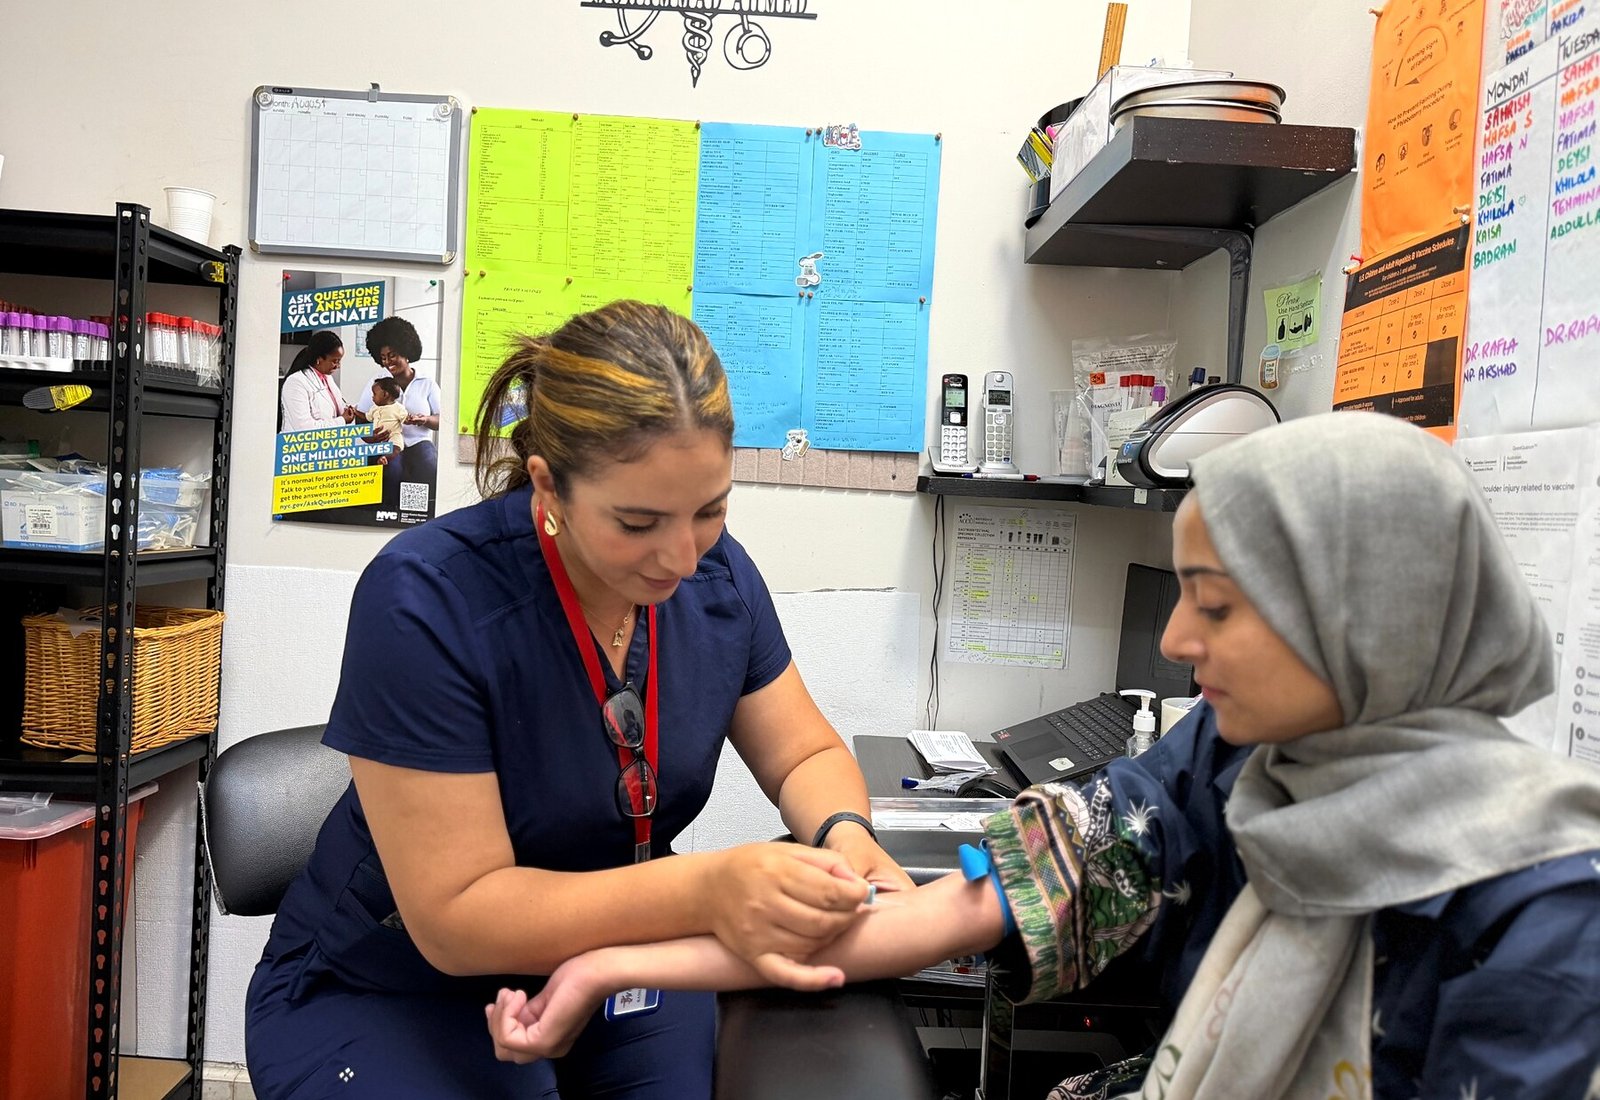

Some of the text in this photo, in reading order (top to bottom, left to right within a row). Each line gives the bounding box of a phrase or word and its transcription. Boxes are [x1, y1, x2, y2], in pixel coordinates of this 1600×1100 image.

[1487, 67, 1529, 105] MONDAY
[1561, 76, 1600, 108] HAFSA
[1485, 92, 1531, 130] SAHRISH
[1559, 100, 1595, 129] HAFSA
[1483, 121, 1517, 149] HAFSA
[1524, 110, 1533, 129] S
[1557, 120, 1597, 152] FATIMA
[1482, 141, 1513, 170] HAFSA
[1519, 133, 1528, 150] N
[1557, 144, 1591, 175] DEYSI
[1480, 163, 1513, 189] FATIMA
[1555, 166, 1595, 196] KHILOLA
[1478, 185, 1506, 210] DEYSI
[1478, 199, 1515, 226] KHILOLA
[1431, 237, 1455, 253] Schedules
[1476, 223, 1502, 246] KAISA
[1473, 238, 1517, 269] BADRAN
[288, 286, 380, 305] ASK QUESTIONS
[288, 295, 379, 315] GET ANSWERS
[287, 307, 378, 328] VACCINATE
[283, 426, 371, 443] VACCINES HAVE
[282, 438, 353, 454] SAVED OVER
[282, 444, 391, 464] ONE MILLION LIVES
[281, 456, 365, 474] SINCE THE 90s!
[280, 478, 290, 486] It's
[291, 476, 314, 485] normal
[325, 473, 349, 483] parents
[358, 471, 379, 479] worry.
[281, 486, 293, 494] Talk
[303, 484, 317, 493] your
[319, 481, 339, 490] child's
[340, 480, 361, 488] doctor
[1503, 484, 1520, 493] injury
[1520, 483, 1542, 492] related
[1552, 482, 1575, 491] vaccine
[279, 497, 349, 511] nyc.gov/AskQuestions
[280, 494, 291, 503] get
[303, 491, 329, 499] answers
[329, 490, 342, 498] you
[376, 511, 398, 520] NYC
